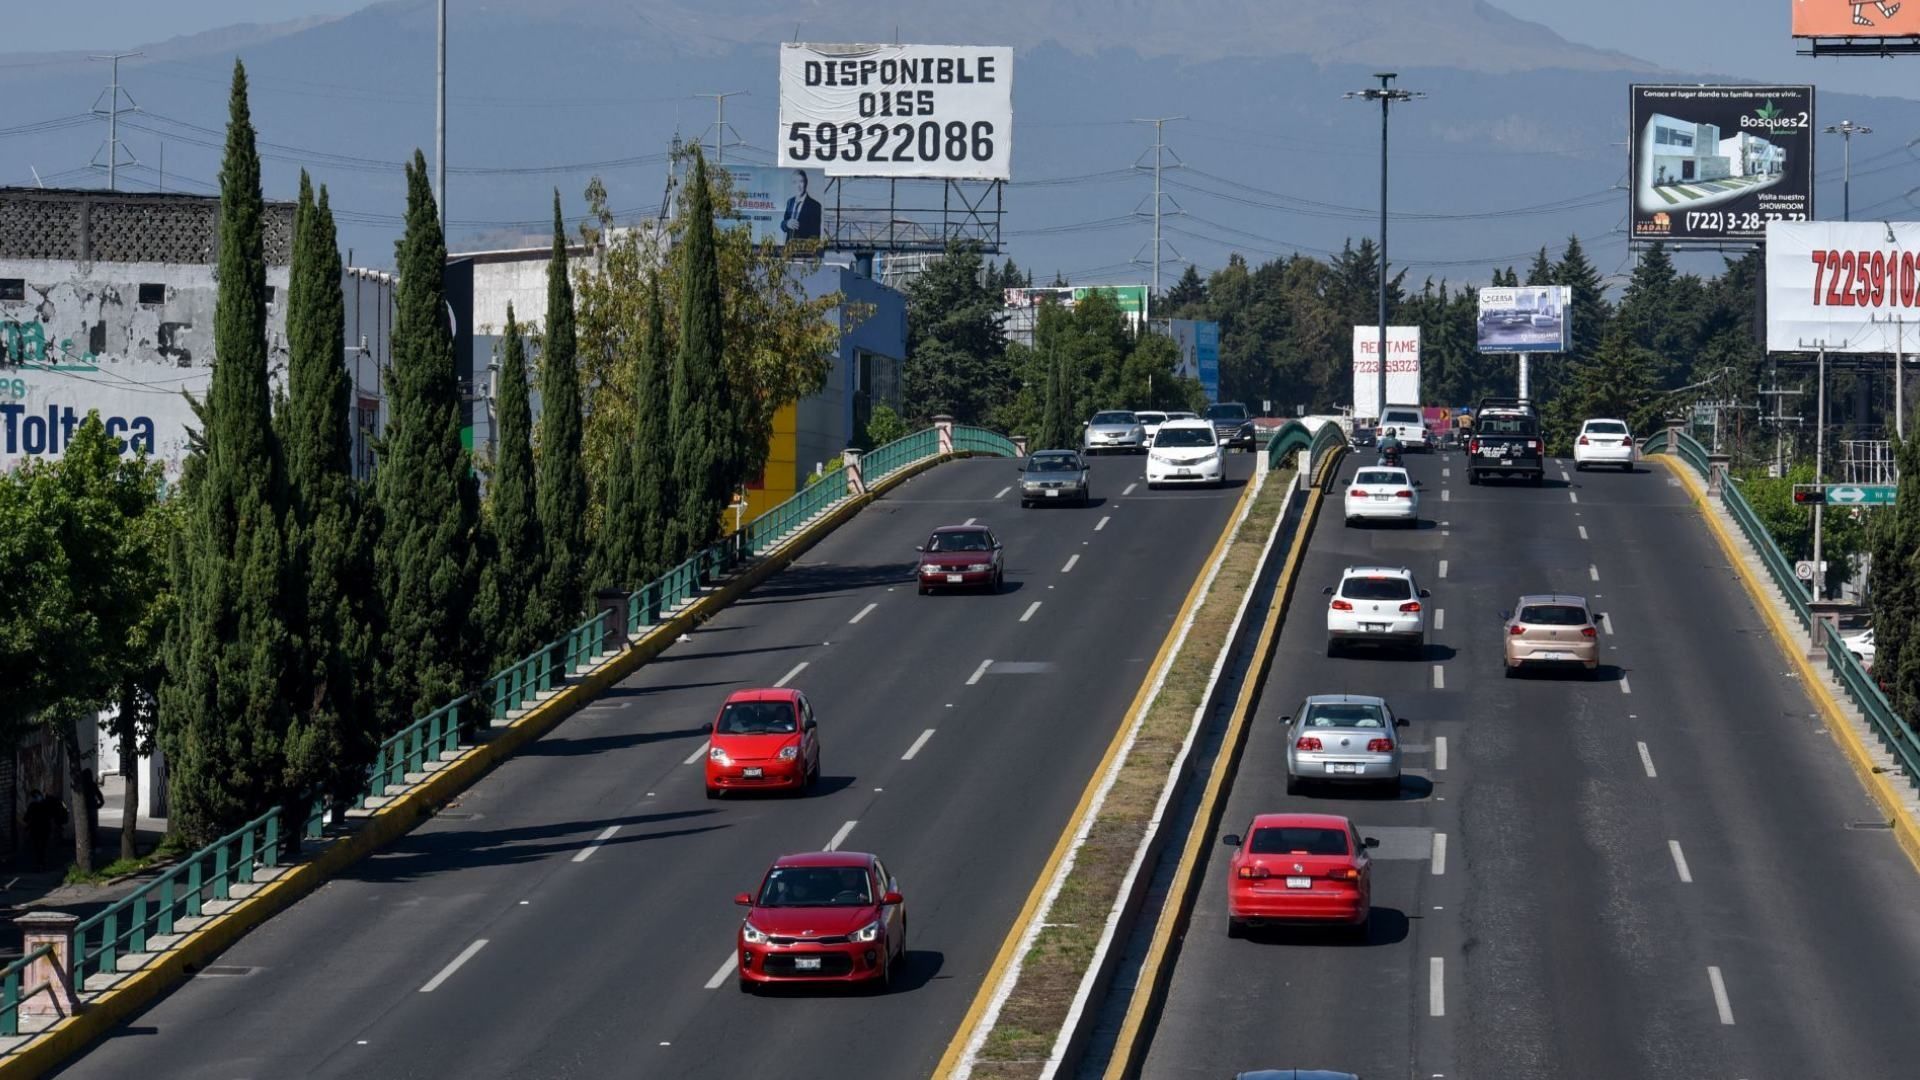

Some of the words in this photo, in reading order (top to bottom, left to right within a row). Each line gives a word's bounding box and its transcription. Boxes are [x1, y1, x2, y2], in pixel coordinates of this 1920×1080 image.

[805, 57, 995, 86] DISPONIBLE
[1643, 90, 1669, 98] Conoce
[1678, 90, 1696, 99] lugar
[1697, 90, 1720, 98] donde
[788, 120, 994, 162] 59322086
[1757, 193, 1777, 201] Visita
[1686, 211, 1723, 232] (722)
[1360, 340, 1417, 354] RETAME
[0, 403, 156, 455] Toltca
